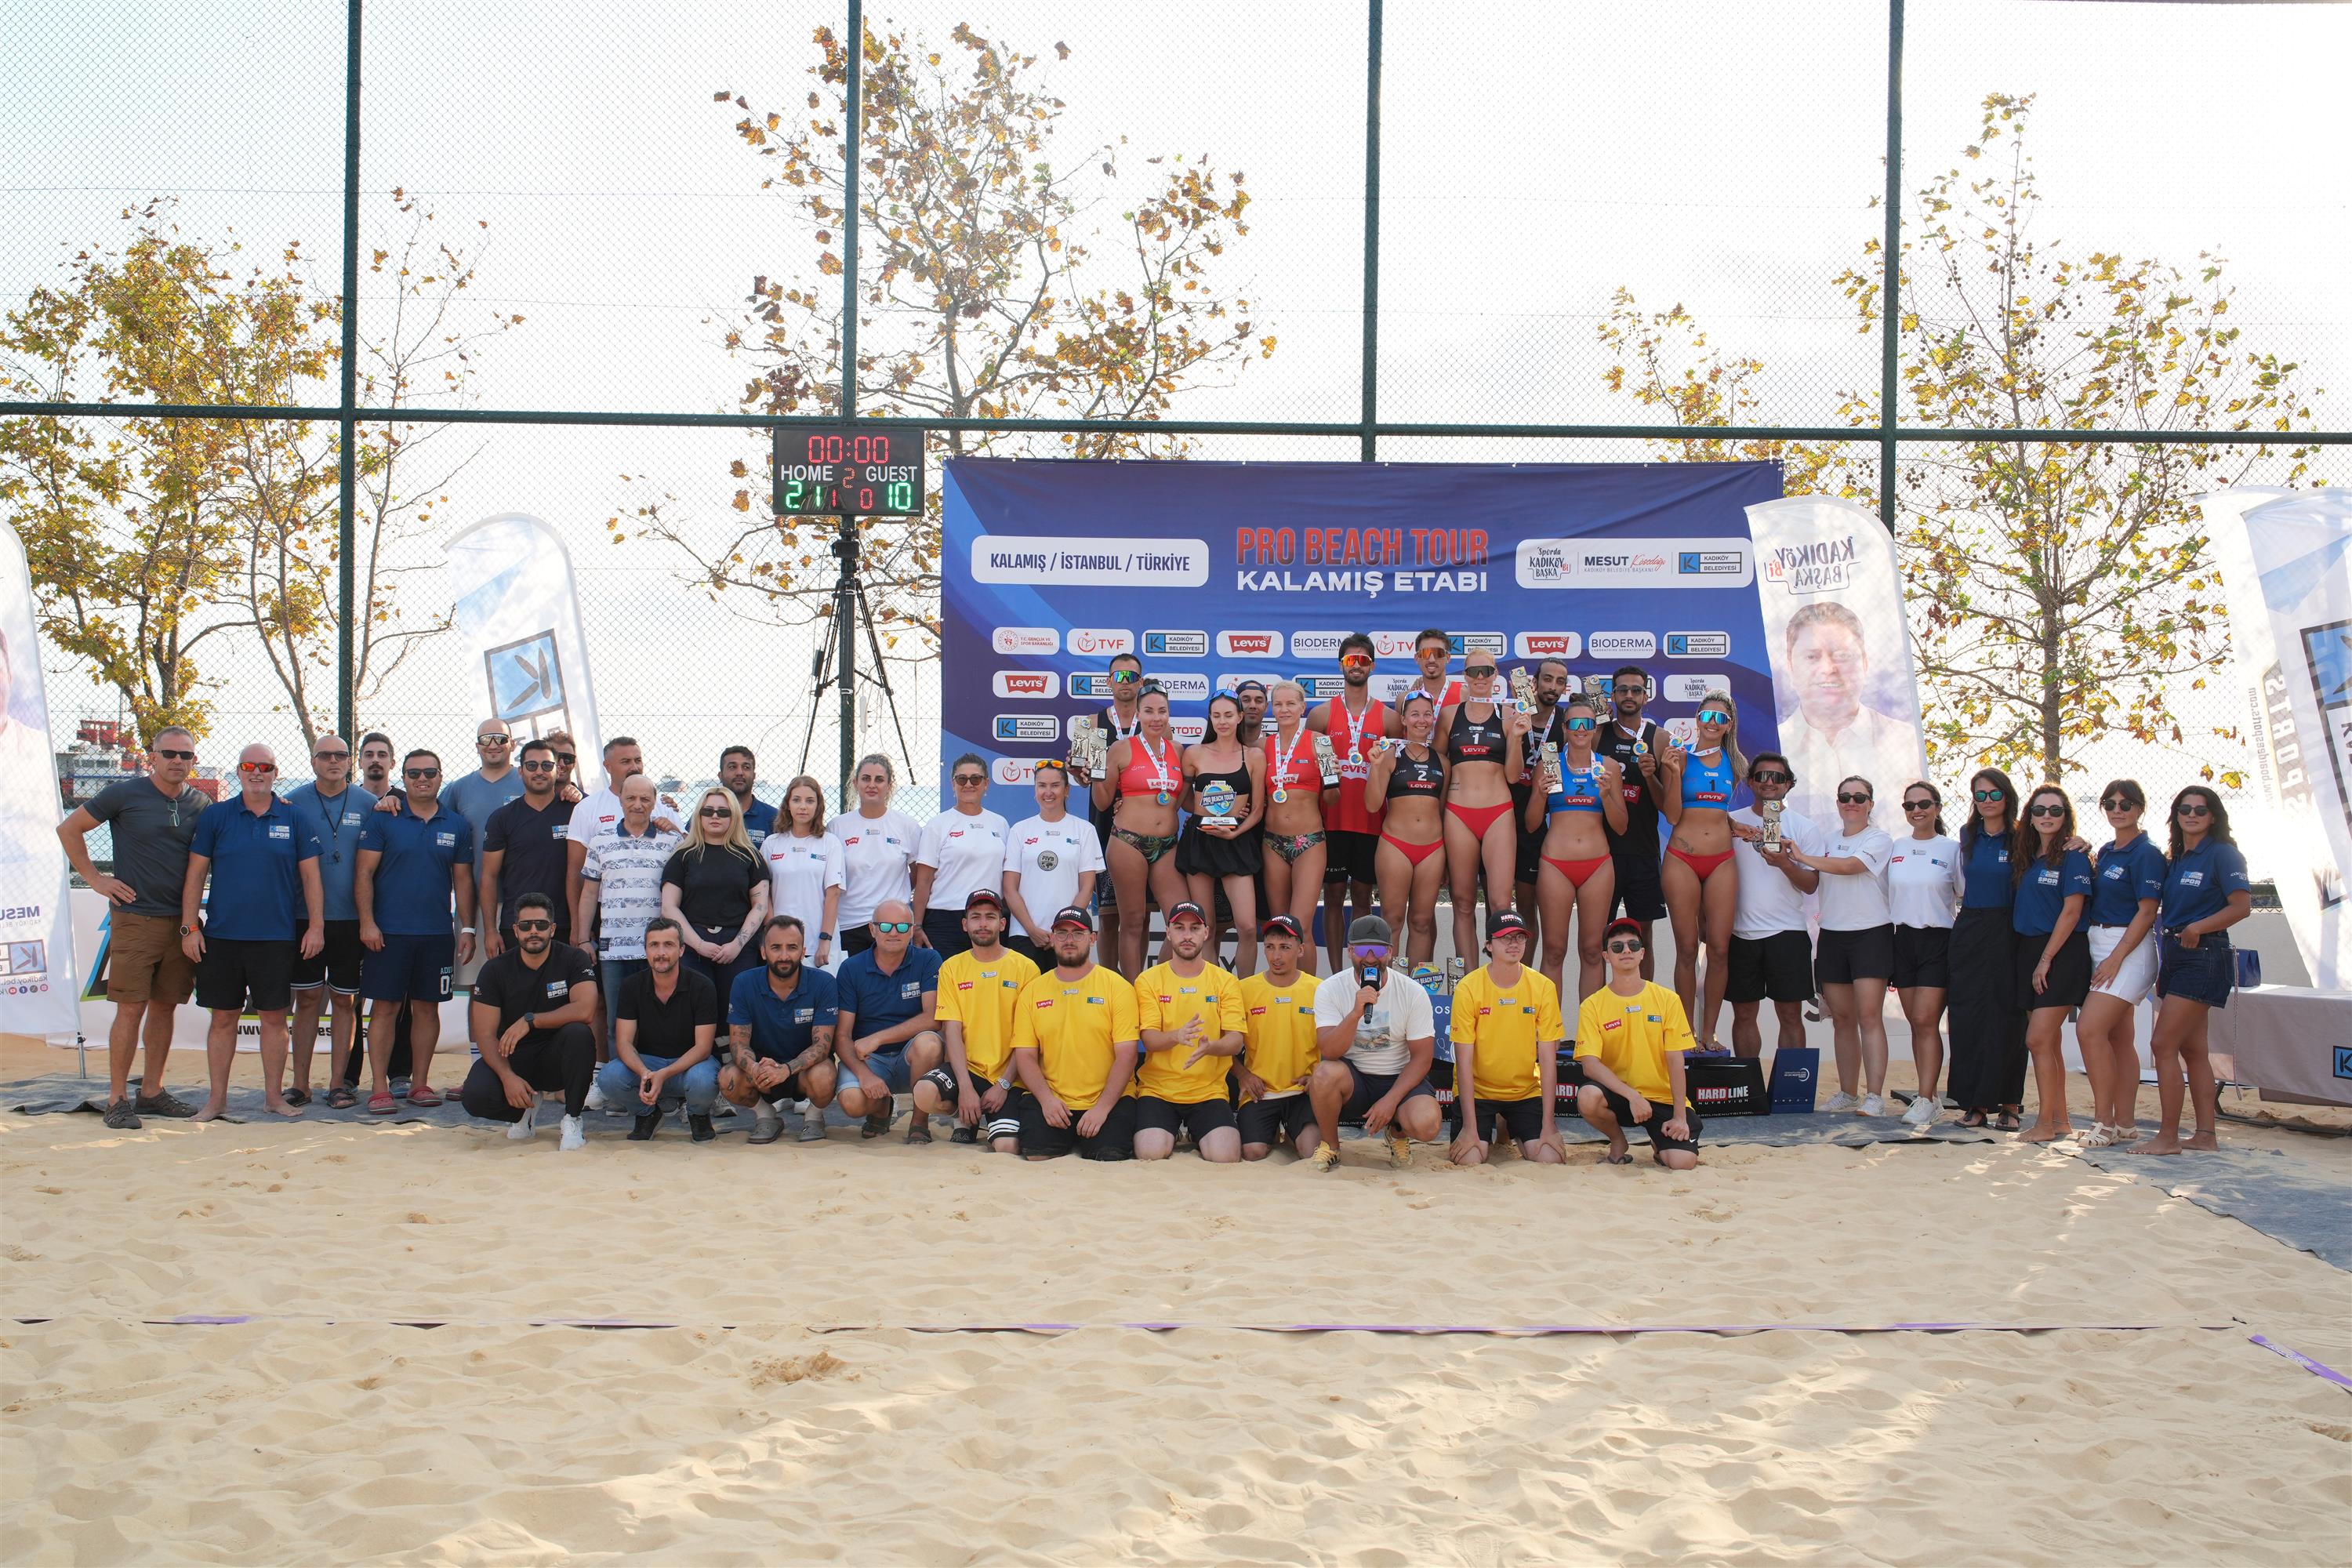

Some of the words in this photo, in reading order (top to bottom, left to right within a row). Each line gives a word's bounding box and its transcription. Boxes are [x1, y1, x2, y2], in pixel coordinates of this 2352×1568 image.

[808, 436, 889, 464] 00:00
[781, 465, 833, 481] HOME
[866, 466, 917, 482] GUEST
[842, 467, 855, 488] 2
[860, 488, 873, 509] 0
[888, 482, 912, 510] 10
[1237, 527, 1295, 565] PRO
[1305, 528, 1402, 566] BEACH
[1411, 528, 1488, 567] TOUR
[991, 553, 1046, 572] KALAMIŞ
[1061, 552, 1121, 571] İSTANBUL
[1136, 553, 1190, 572] TÜRKİYE
[1530, 556, 1564, 568] KADIKÖY
[1584, 556, 1629, 566] MESUT
[1536, 568, 1558, 579] BAŞKA
[1237, 571, 1384, 599] KALAMIŞ
[1395, 572, 1486, 592] ETABI
[1098, 639, 1124, 650] TVF
[1397, 641, 1414, 652] TV
[1592, 638, 1653, 648] BIODERMA
[1472, 733, 1479, 745] 1
[1417, 771, 1427, 781] 2
[1574, 785, 1584, 795] 2
[1709, 779, 1715, 791] 1
[1698, 1089, 1728, 1100] HARD
[1728, 1086, 1748, 1098] LINE
